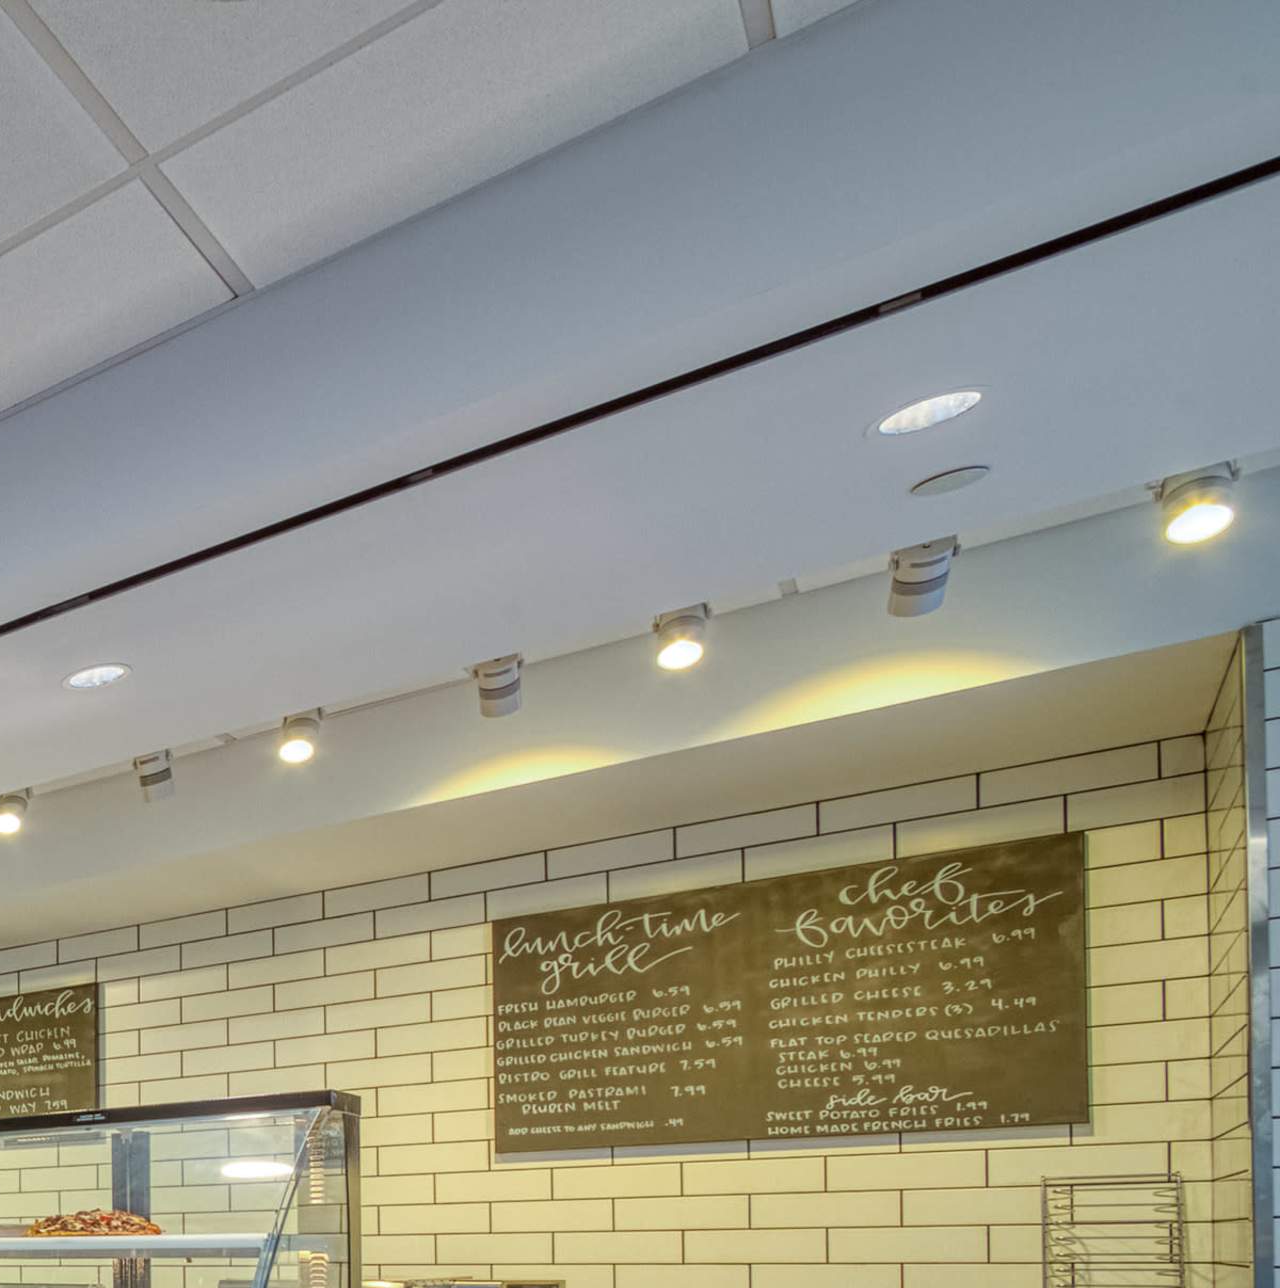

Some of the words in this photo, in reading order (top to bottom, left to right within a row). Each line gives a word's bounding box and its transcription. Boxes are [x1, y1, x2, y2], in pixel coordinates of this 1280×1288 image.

[840, 862, 972, 905] chef
[775, 889, 1063, 948] favorites
[774, 951, 834, 970] PHILLY
[845, 938, 966, 960] CHEESESTEAK
[992, 927, 1036, 944] 6.99
[540, 943, 693, 995] grill
[769, 971, 846, 989] CHICKEN
[856, 962, 920, 980] PHILLY
[939, 956, 985, 971] 6.99
[497, 1001, 538, 1016] FRESH
[546, 990, 637, 1011] HAMBURGER
[652, 985, 690, 998] 6.59
[770, 991, 844, 1010] GRILLED
[853, 985, 921, 1001] CHEESE
[942, 979, 992, 994] 3.29
[498, 1019, 538, 1032] BLACK
[543, 1015, 576, 1029] BEAN
[583, 1011, 626, 1024] VEGGIE
[633, 1004, 690, 1021] BURGER
[768, 1013, 849, 1030] CHICKEN
[856, 1005, 939, 1021] TENDERS
[944, 1003, 973, 1017] (3)
[991, 996, 1037, 1010] 4.49
[16, 1026, 71, 1043] CHICKEN
[496, 1035, 555, 1050] GRILLED
[560, 1030, 619, 1044] TURKEY
[626, 1023, 686, 1040] BURGER
[697, 1018, 736, 1032] 6.59
[770, 1037, 806, 1049] FLAT
[815, 1034, 847, 1046] TOP
[854, 1031, 917, 1044] SEARED
[925, 1019, 1059, 1041] QUESADILLAS
[10, 1042, 44, 1057] WRAP
[497, 1054, 546, 1067] GRILLED
[550, 1049, 608, 1063] CHICKEN
[614, 1041, 692, 1058] SANDWICH
[705, 1036, 743, 1049] 6.59
[778, 1050, 829, 1062] STEAK
[839, 1046, 878, 1059] 6.99
[498, 1072, 550, 1084] BISTRO
[559, 1069, 597, 1080] GRILL
[605, 1062, 666, 1077] FEATURE
[679, 1058, 716, 1071] 7.59
[775, 1061, 852, 1076] CHICKEN
[864, 1058, 901, 1070] 6.99
[778, 1075, 840, 1089] CHEESE
[852, 1073, 896, 1085] 5.99
[9, 1101, 37, 1114] WAY
[498, 1090, 558, 1104] SMOKED
[569, 1085, 646, 1100] PASTRAMI
[670, 1085, 706, 1097] 7.99
[522, 1102, 576, 1115] REUBEN
[583, 1100, 621, 1112] MELT
[825, 1088, 888, 1110] side
[892, 1084, 974, 1104] bar
[766, 1110, 813, 1121] SWEET
[819, 1108, 880, 1120] POTATO
[889, 1104, 939, 1117] FRIES
[956, 1101, 988, 1112] 1.99
[768, 1124, 810, 1135] HOME
[816, 1122, 860, 1133] MADE
[863, 1119, 927, 1132] FRENCH
[935, 1115, 982, 1128] FRIES
[1000, 1112, 1031, 1123] 1.79
[508, 1127, 528, 1136] ADD
[530, 1125, 562, 1134] CHEESE
[563, 1125, 575, 1133] TO
[576, 1123, 597, 1132] ANY
[599, 1120, 654, 1130] SANDWICH
